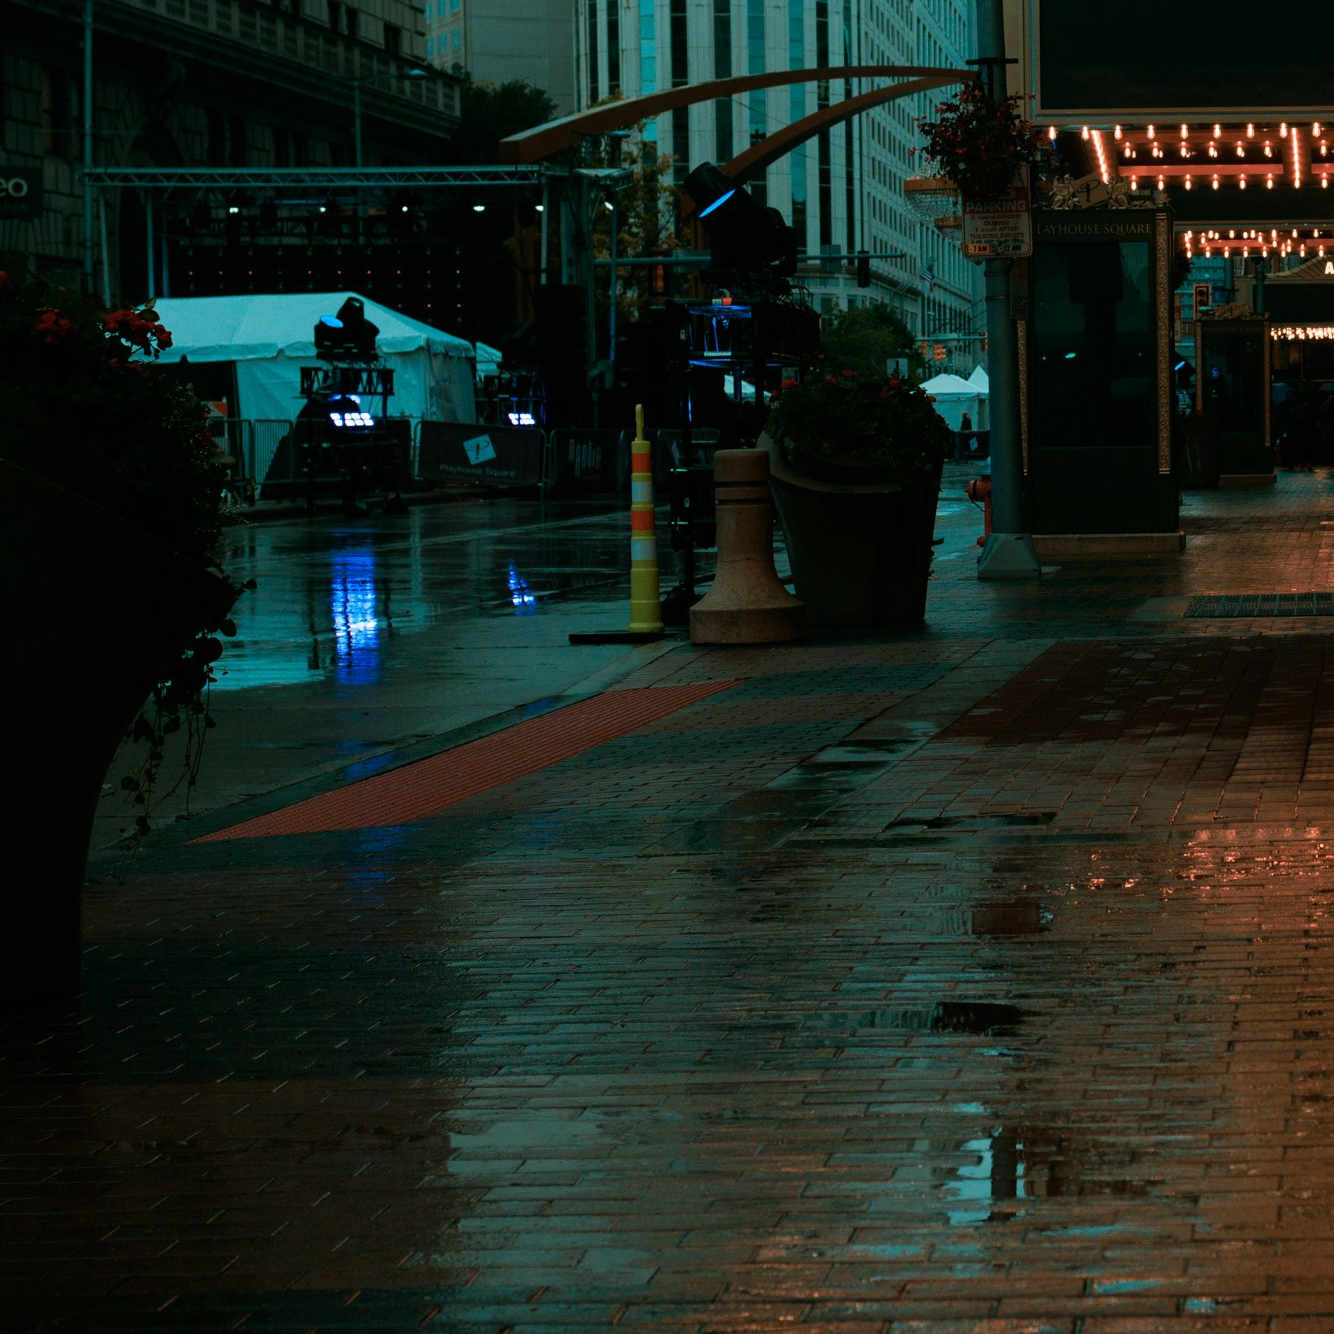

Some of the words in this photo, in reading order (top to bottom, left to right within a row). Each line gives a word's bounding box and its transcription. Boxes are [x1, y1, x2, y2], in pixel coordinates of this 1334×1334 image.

[965, 200, 1027, 213] PARKING
[1036, 223, 1102, 235] LAYHOUSE
[1104, 223, 1153, 236] SQUARE
[439, 463, 483, 475] Playhouse
[484, 466, 517, 477] Square
